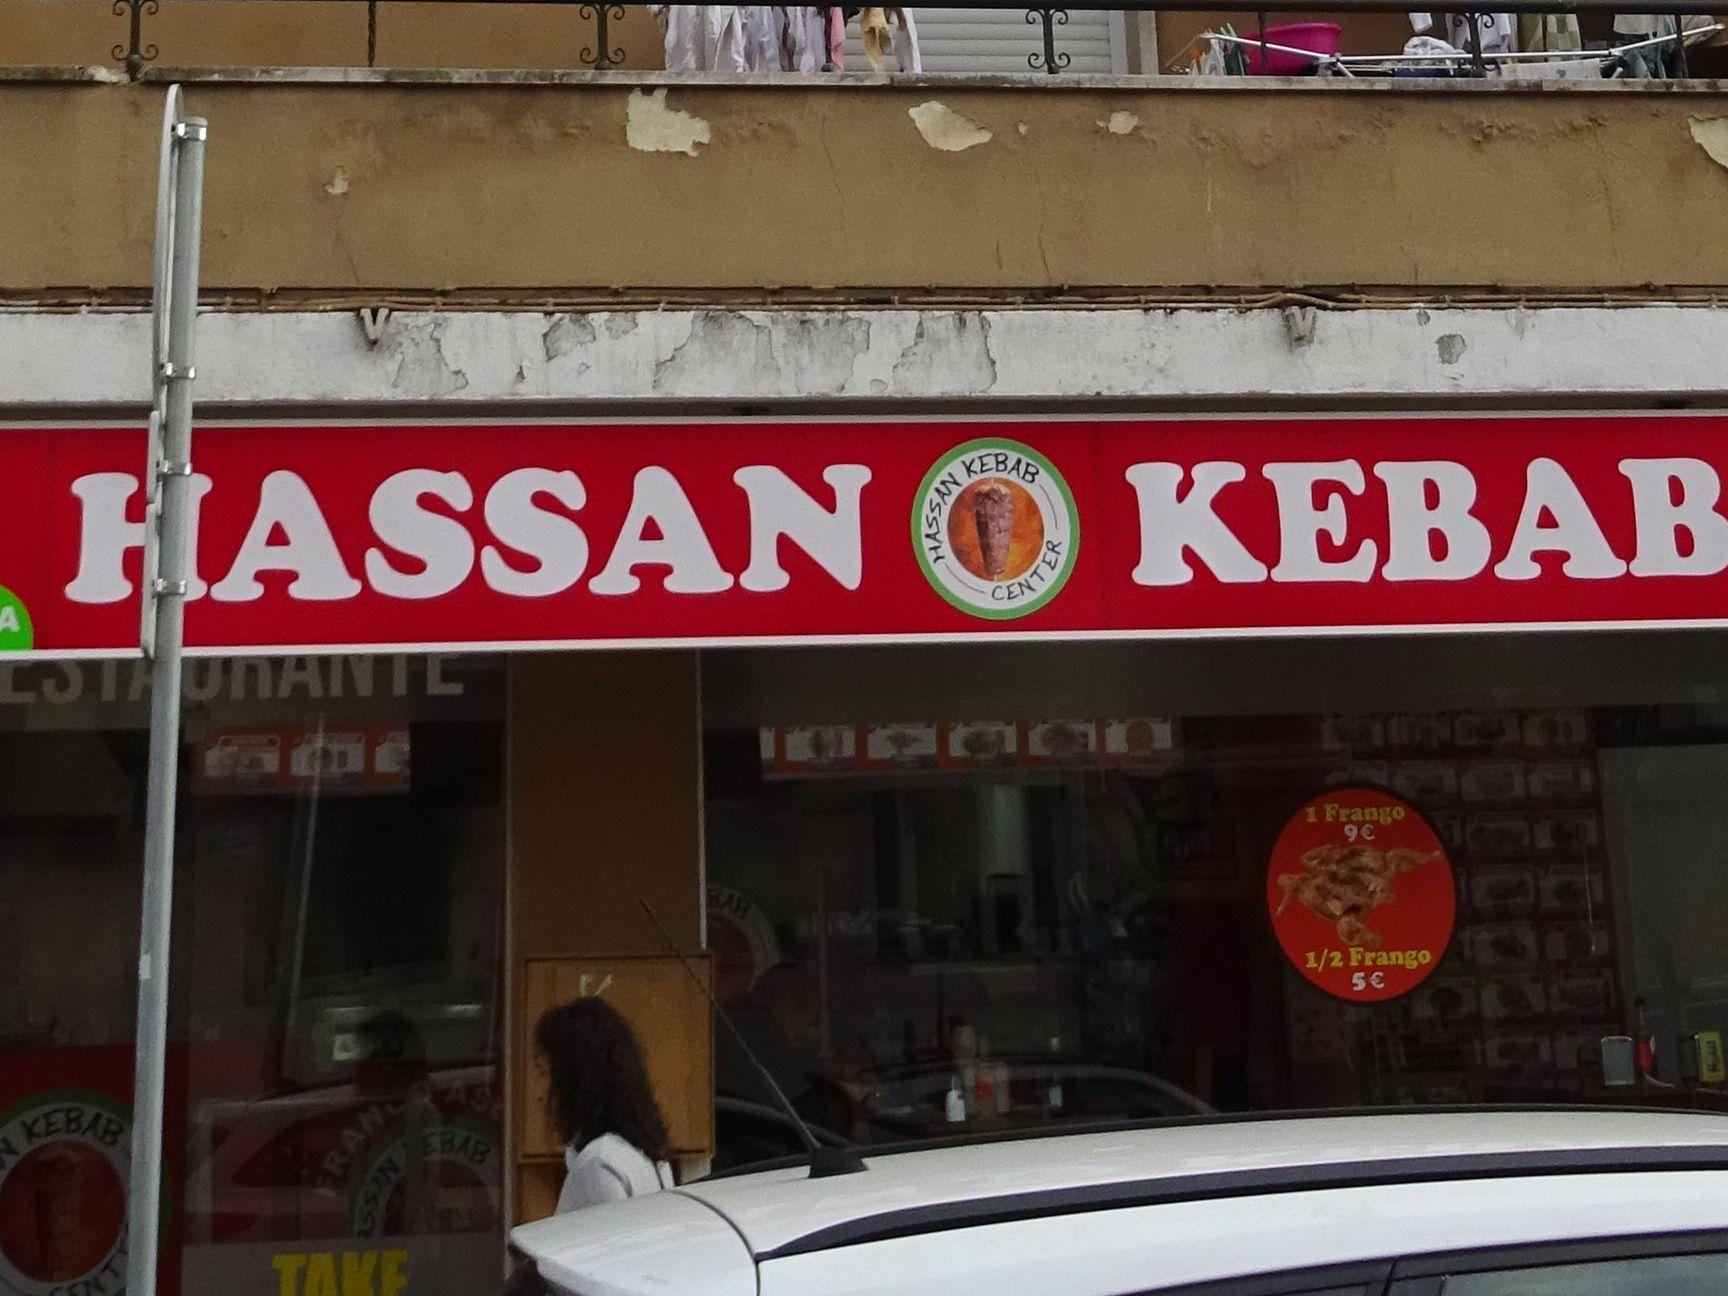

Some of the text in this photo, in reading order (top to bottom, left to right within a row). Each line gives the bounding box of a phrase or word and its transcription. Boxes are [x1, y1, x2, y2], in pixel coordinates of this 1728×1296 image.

[922, 452, 1040, 565] HASSAN KEBAB
[65, 463, 872, 604] HASSAN
[992, 540, 1062, 601] CENTER
[1305, 803, 1406, 825] 1 Frango
[1305, 947, 1432, 972] 1/2 Frango
[21, 1106, 125, 1146] KEBAB
[272, 1248, 408, 1296] TAKE
